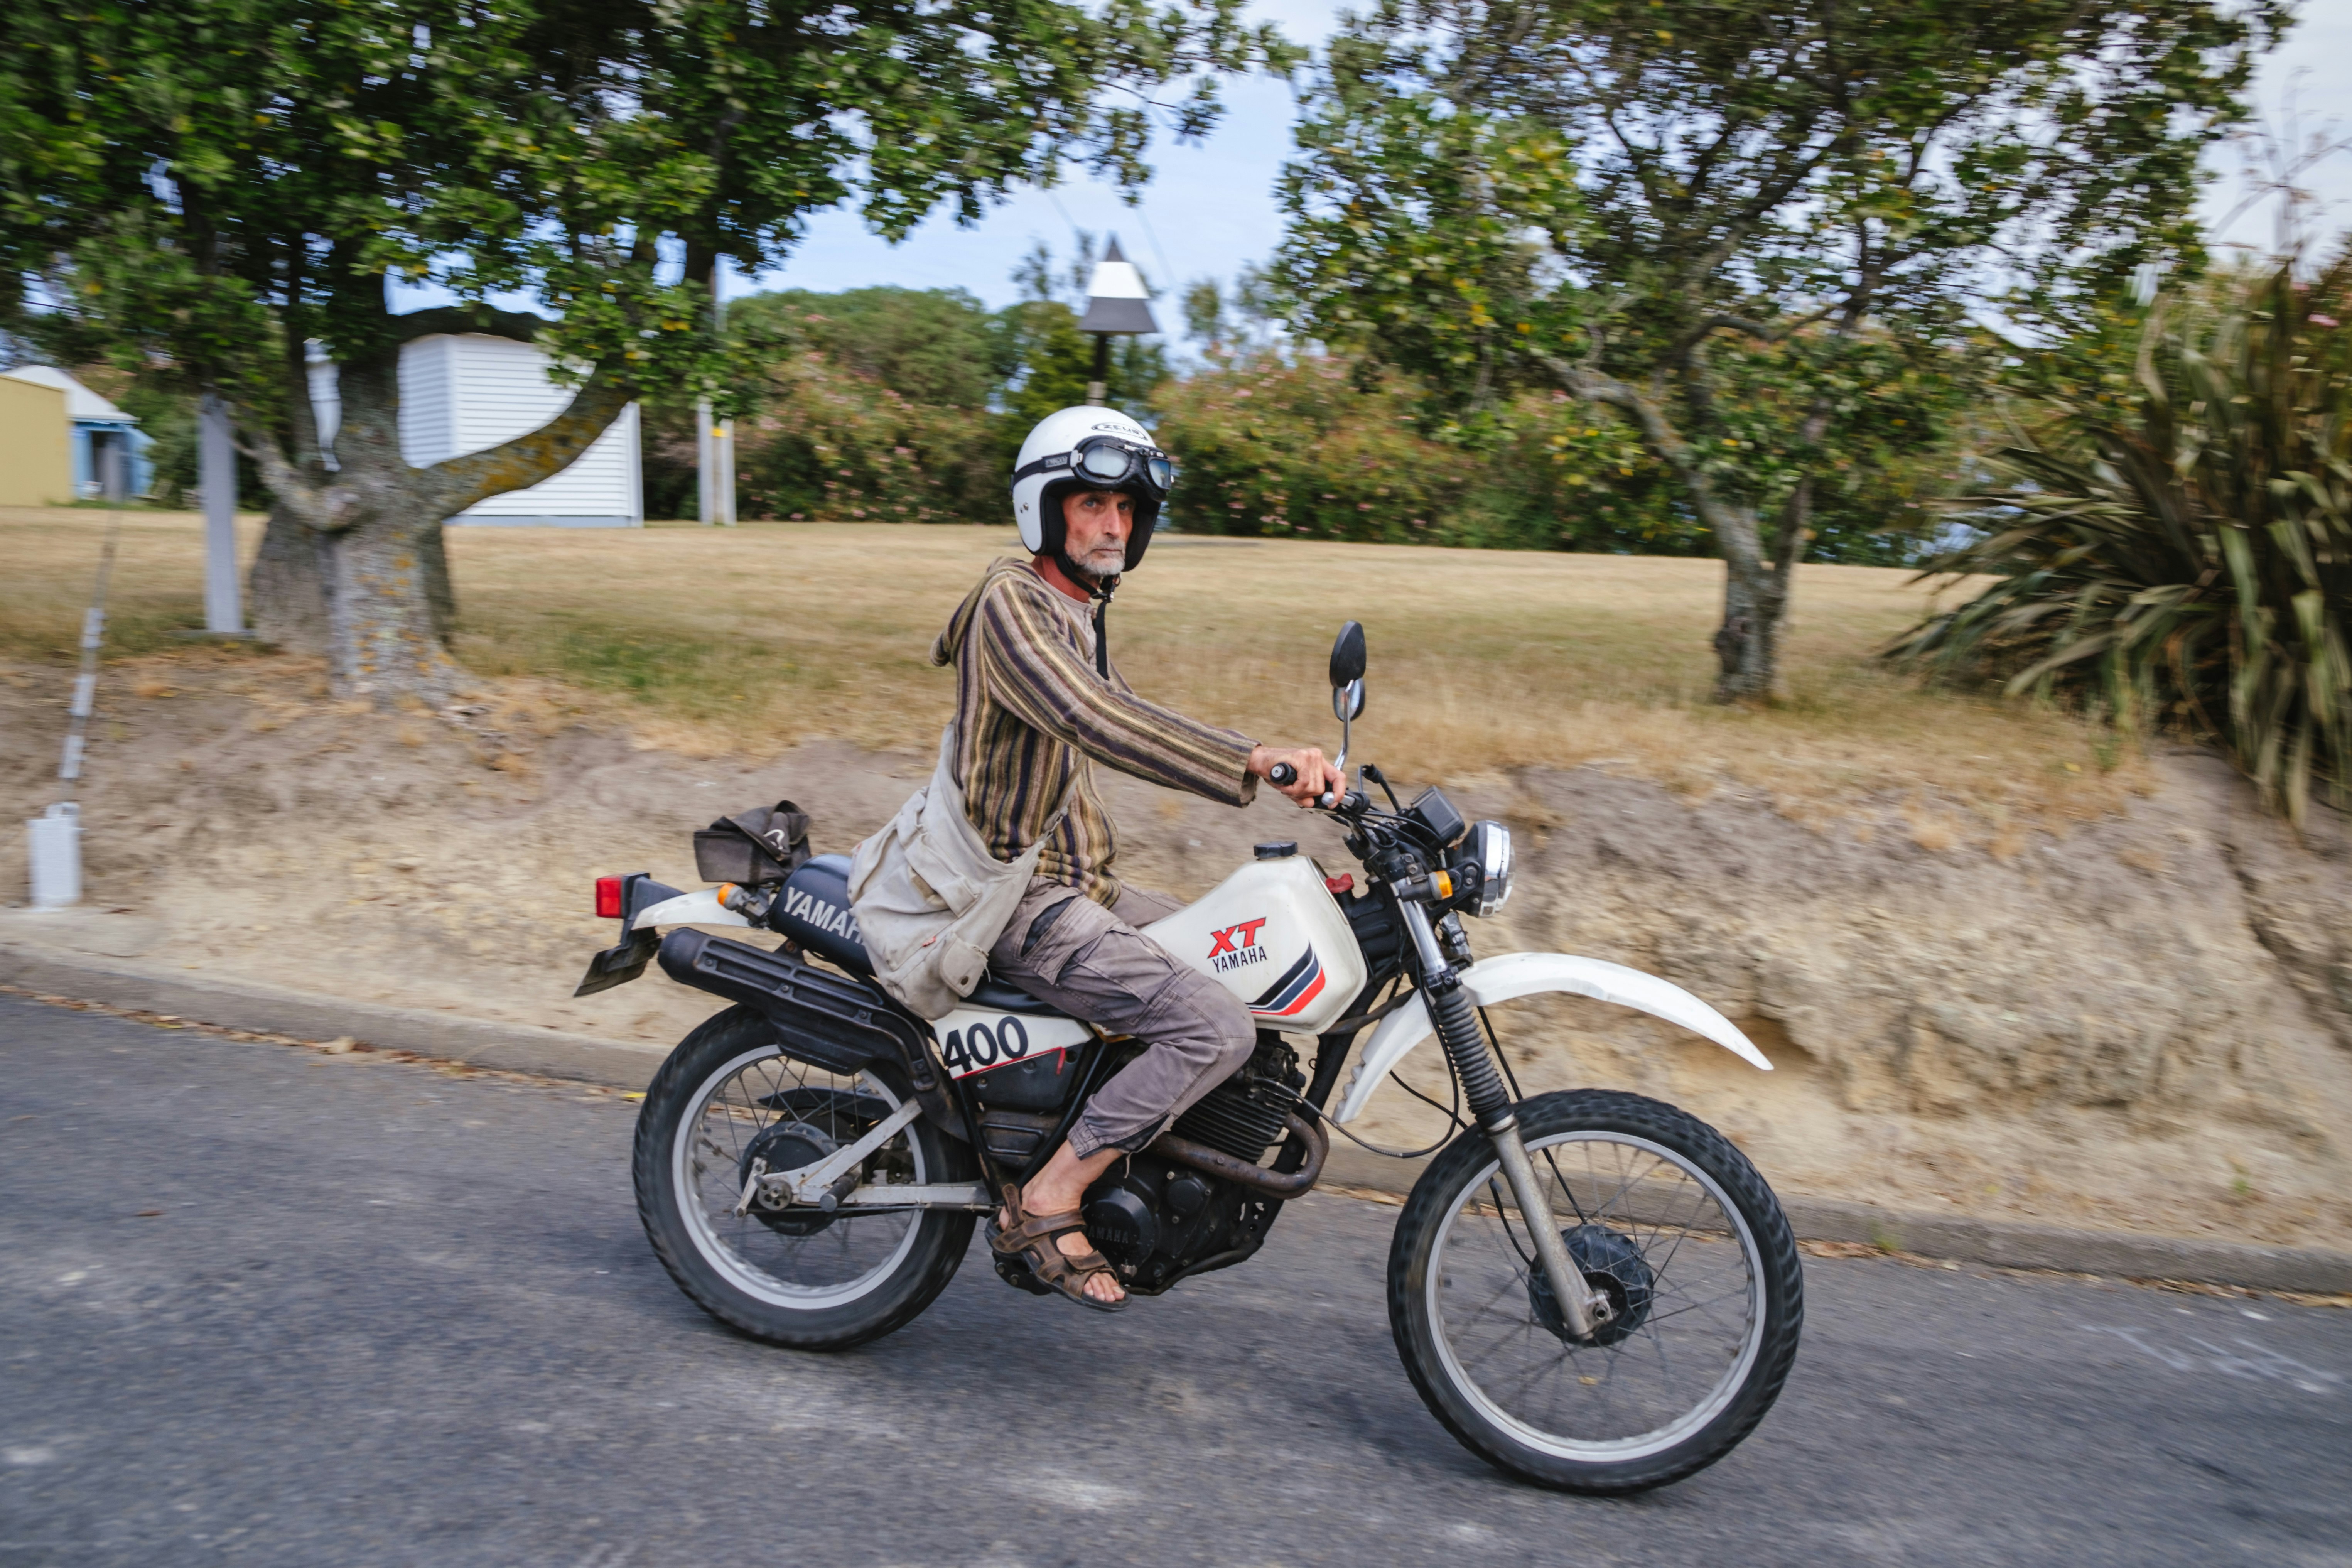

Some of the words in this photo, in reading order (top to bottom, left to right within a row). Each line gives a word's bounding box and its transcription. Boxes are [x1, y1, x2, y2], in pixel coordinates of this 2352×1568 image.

[783, 886, 863, 944] YAMAH
[1207, 916, 1266, 959] XT
[1212, 946, 1268, 973] YAMAHA
[944, 1016, 1028, 1073] 400
[1088, 1225, 1129, 1244] AMAHA
